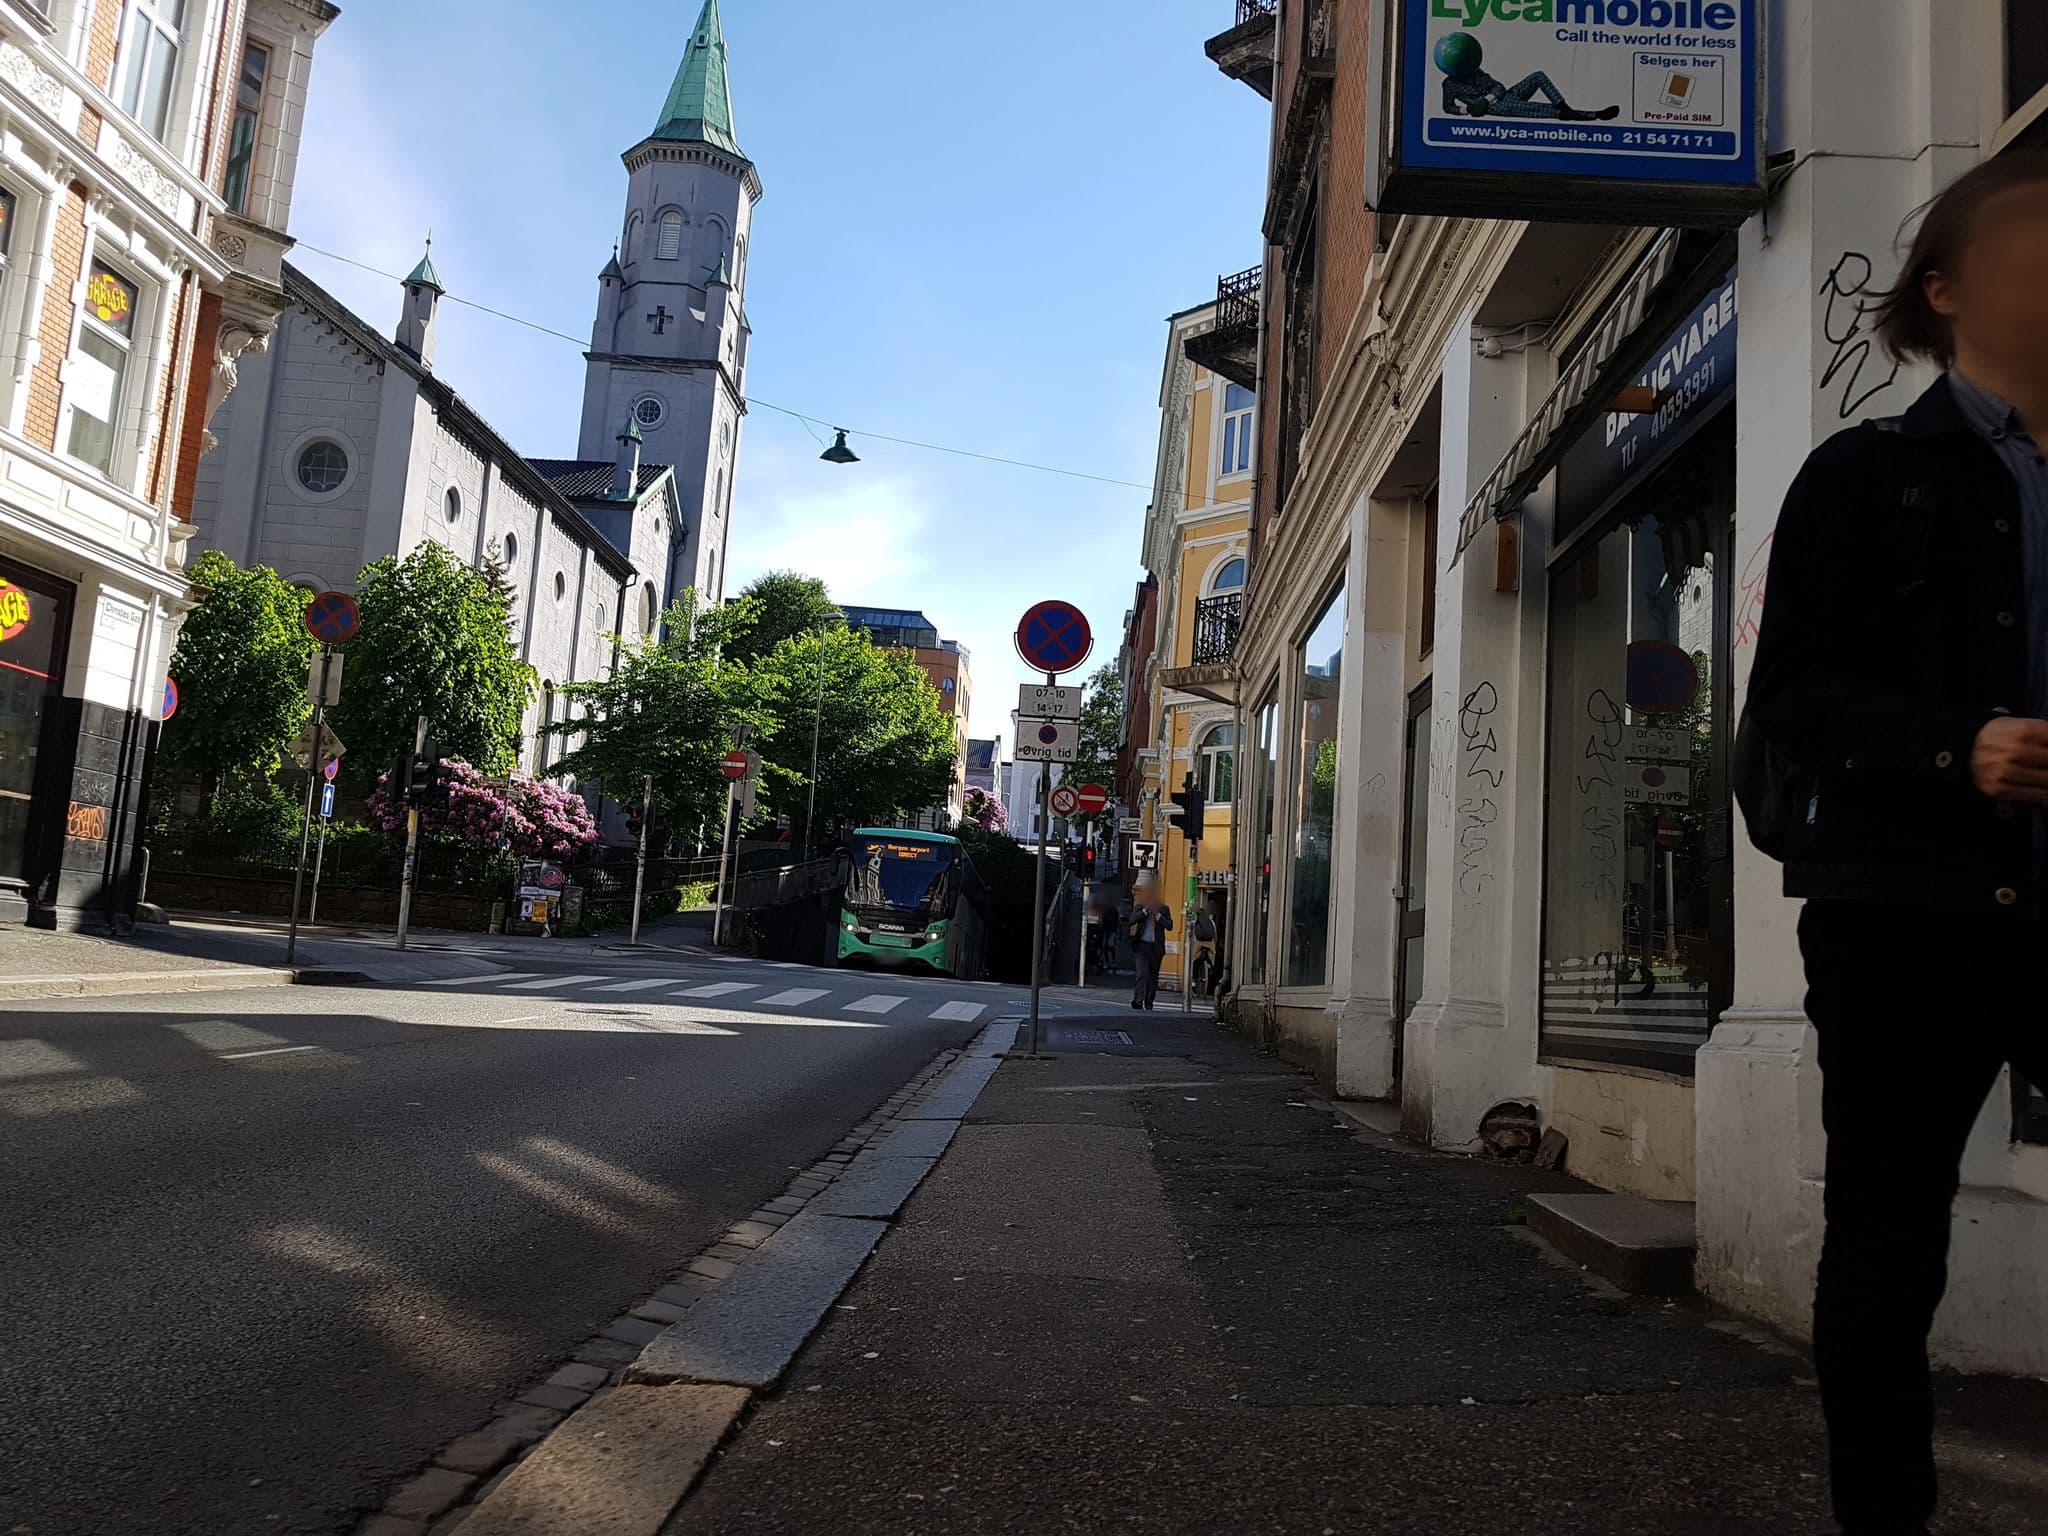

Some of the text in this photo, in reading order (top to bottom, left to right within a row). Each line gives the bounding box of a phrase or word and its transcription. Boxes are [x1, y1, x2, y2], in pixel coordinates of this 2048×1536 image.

[1555, 28, 1736, 49] Call the world for less
[1639, 55, 1718, 68] Selges her
[1644, 112, 1712, 122] Pre-Paid SIM
[1450, 125, 1714, 147] www.lyca-mobile.no 21 54 71 71
[1650, 354, 1716, 440] 40593991
[1022, 745, 1072, 759] Øvrig tid
[878, 923, 905, 932] SCANIA
